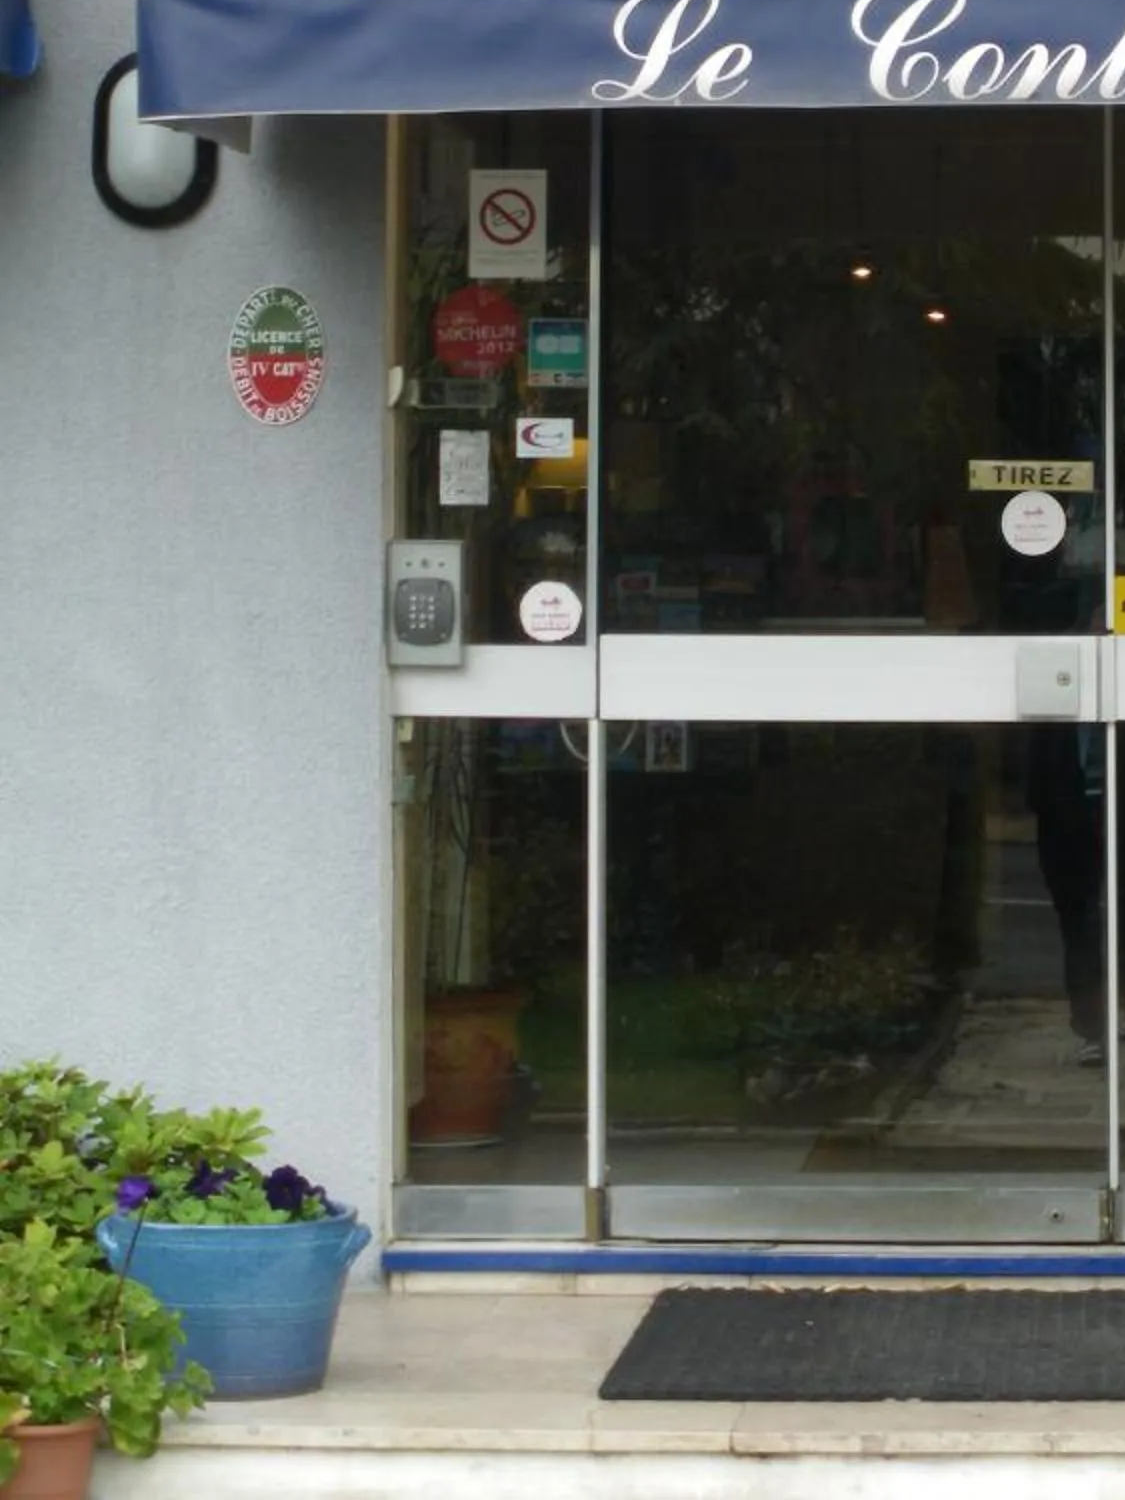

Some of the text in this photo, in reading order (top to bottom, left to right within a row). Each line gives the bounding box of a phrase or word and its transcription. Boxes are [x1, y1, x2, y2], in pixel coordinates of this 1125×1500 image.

[251, 330, 303, 343] LICENCE
[437, 324, 516, 341] MICHELIN
[265, 357, 322, 422] BOISSONS
[992, 465, 1074, 486] TIREZ
